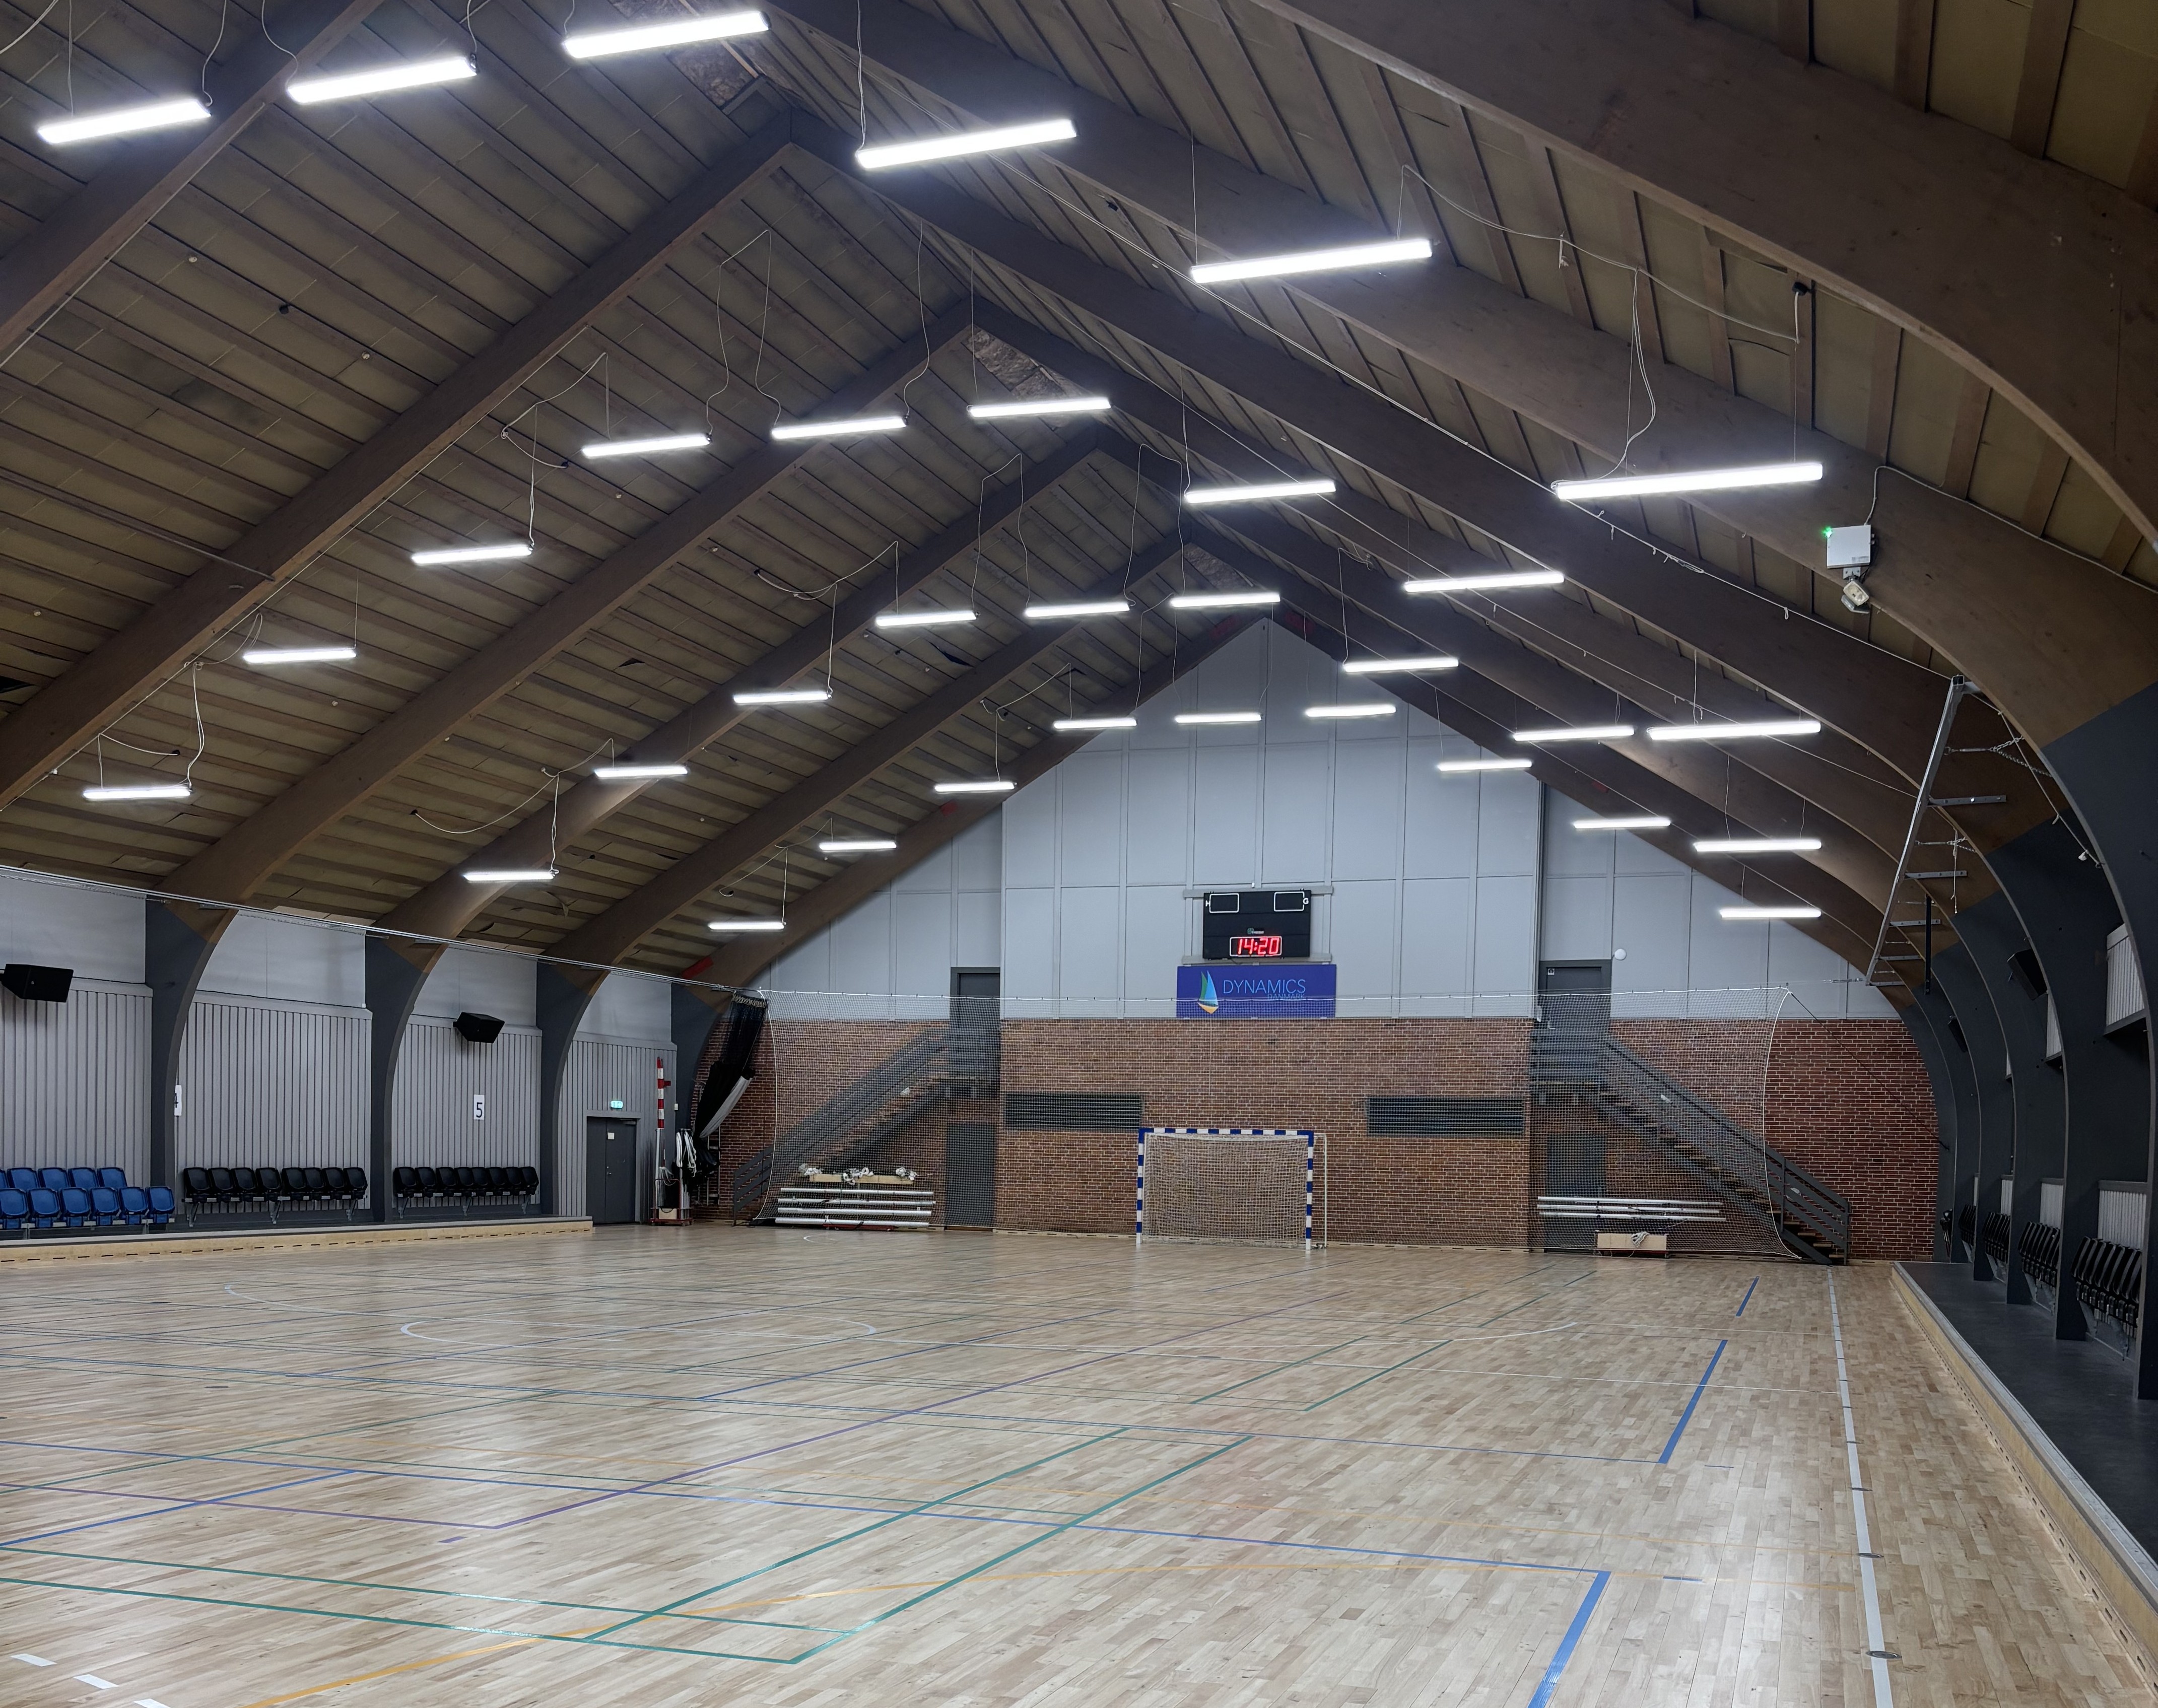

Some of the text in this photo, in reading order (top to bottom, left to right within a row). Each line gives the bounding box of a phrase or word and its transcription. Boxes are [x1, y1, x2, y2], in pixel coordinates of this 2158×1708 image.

[1238, 938, 1279, 954] 14:20
[1223, 979, 1306, 994] DYNAMICS
[476, 1102, 483, 1118] 5
